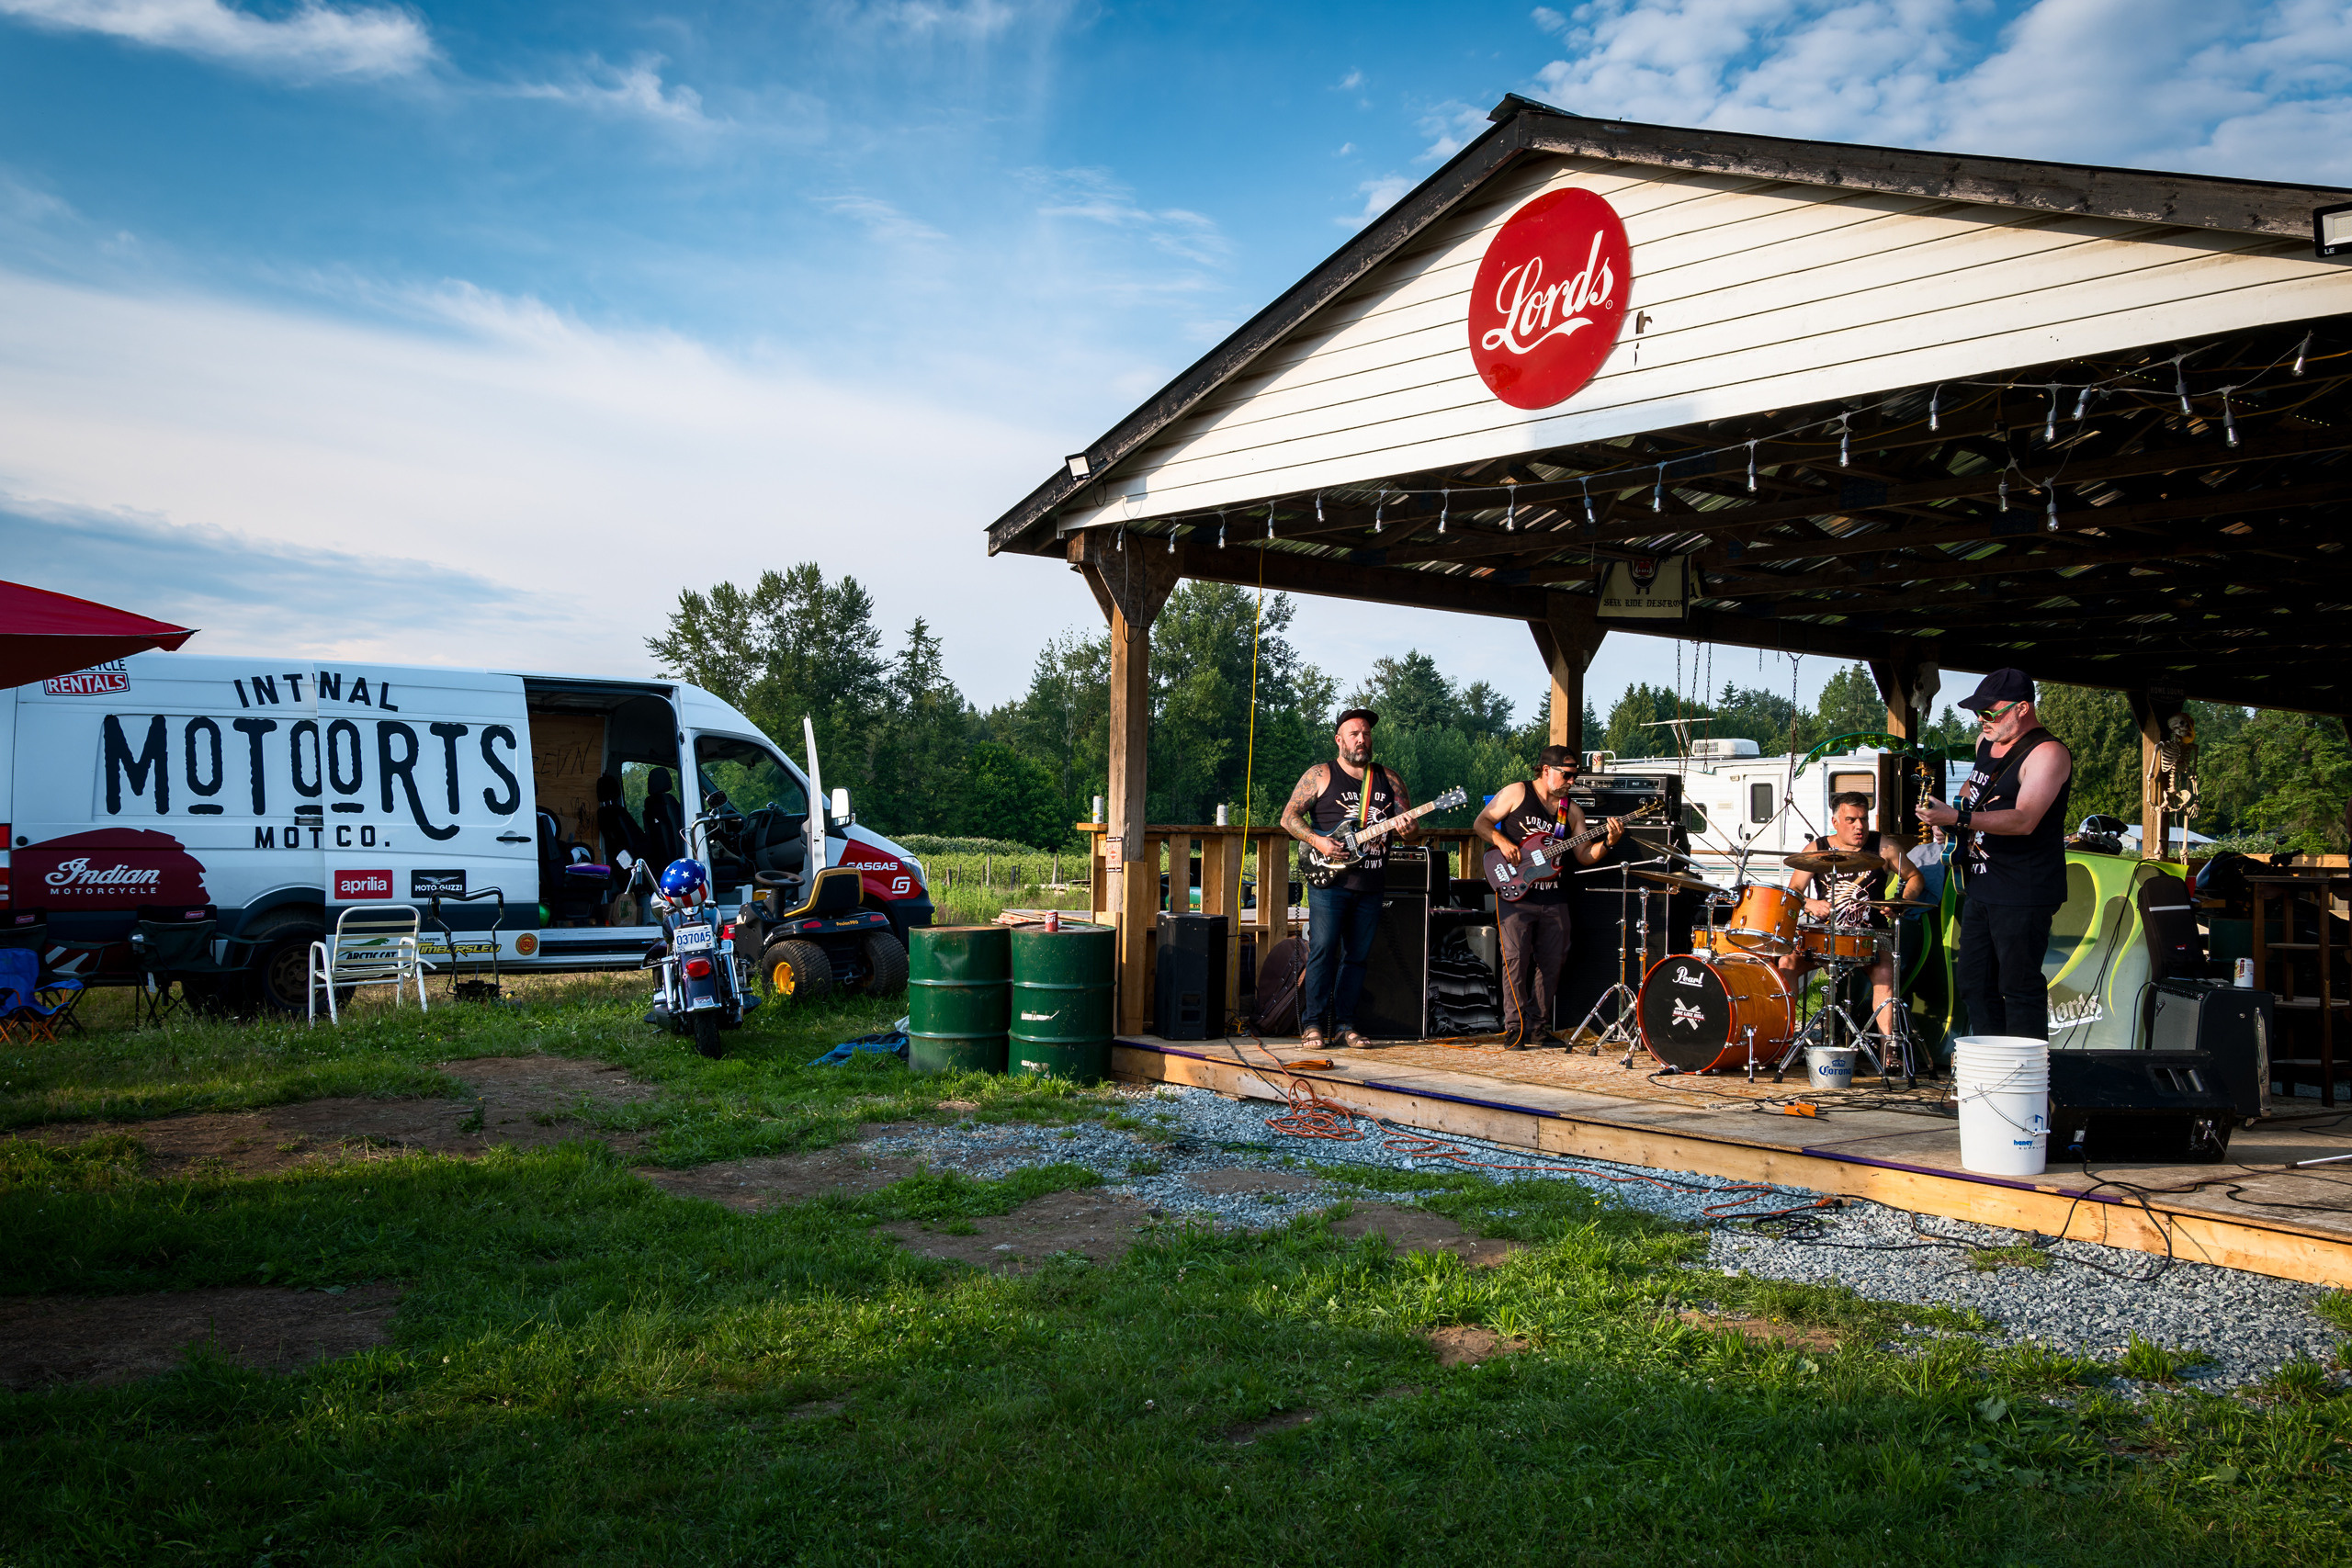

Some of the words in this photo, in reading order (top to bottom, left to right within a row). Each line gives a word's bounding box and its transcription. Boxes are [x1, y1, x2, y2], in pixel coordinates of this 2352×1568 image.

[1481, 230, 1614, 355] Lords
[1625, 598, 1643, 607] RIDE
[47, 675, 126, 694] RENTALS
[1374, 792, 1386, 802] OF
[1525, 816, 1553, 832] LORDS
[45, 858, 160, 886] Indian
[50, 886, 157, 895] MOTORCYCLE
[341, 876, 388, 895] aprilia
[414, 884, 436, 892] MOTO
[439, 884, 463, 892] GUZZI
[676, 931, 711, 946] 0370A5
[346, 951, 379, 960] ARCTIC
[379, 951, 399, 959] CAT
[1672, 965, 1704, 985] Pearl
[2013, 1139, 2033, 1147] haney
